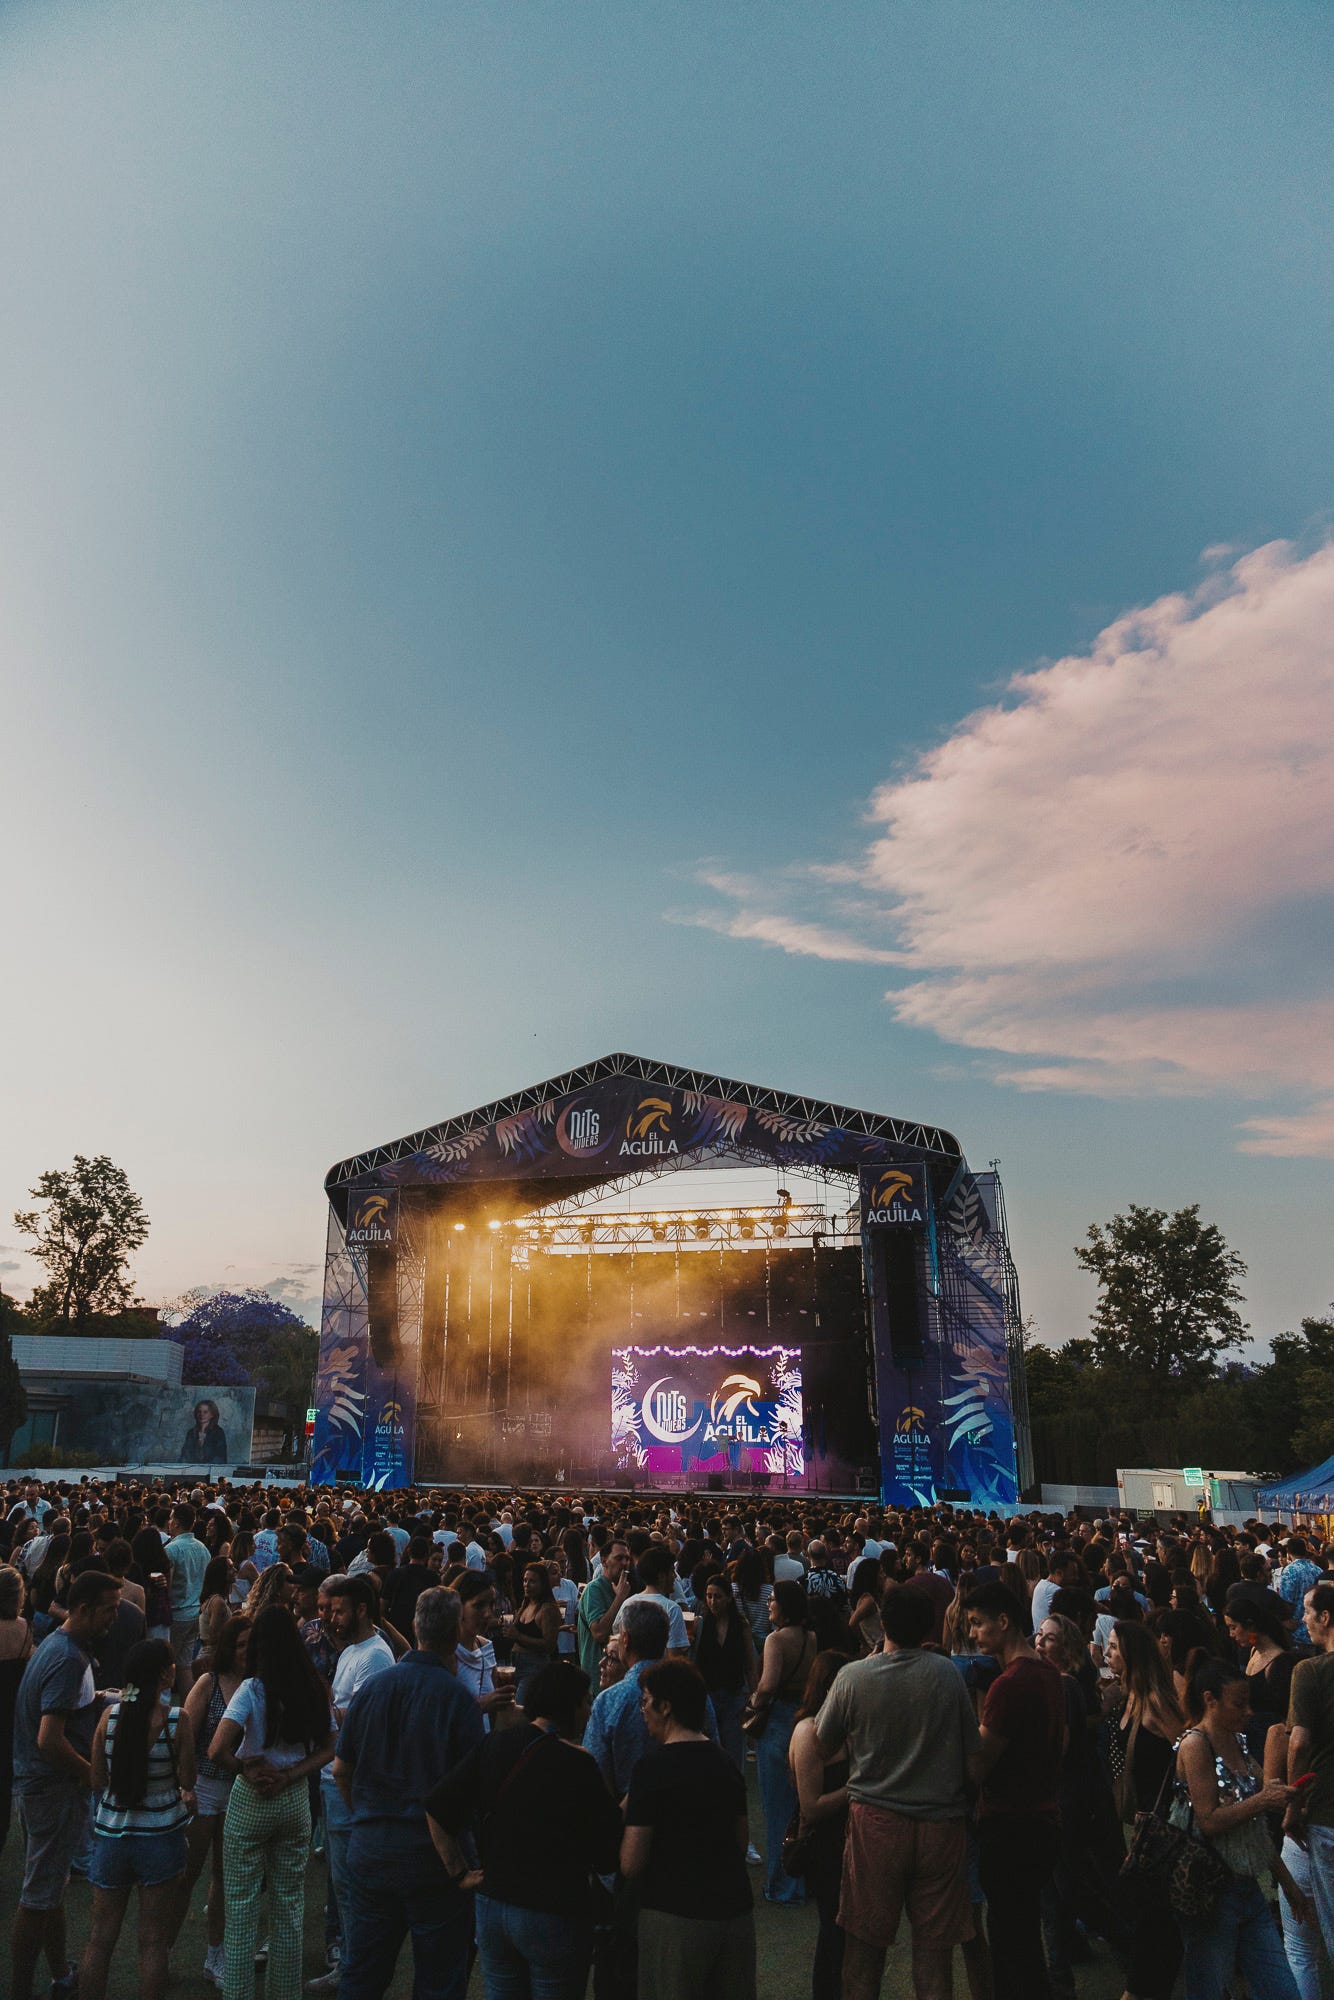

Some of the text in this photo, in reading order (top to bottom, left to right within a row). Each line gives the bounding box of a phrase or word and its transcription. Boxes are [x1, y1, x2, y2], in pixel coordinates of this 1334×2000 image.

[649, 1132, 658, 1140] EL
[619, 1139, 679, 1156] ÁGUILA
[867, 1208, 922, 1223] ÁGUILA
[736, 1415, 747, 1425] EL
